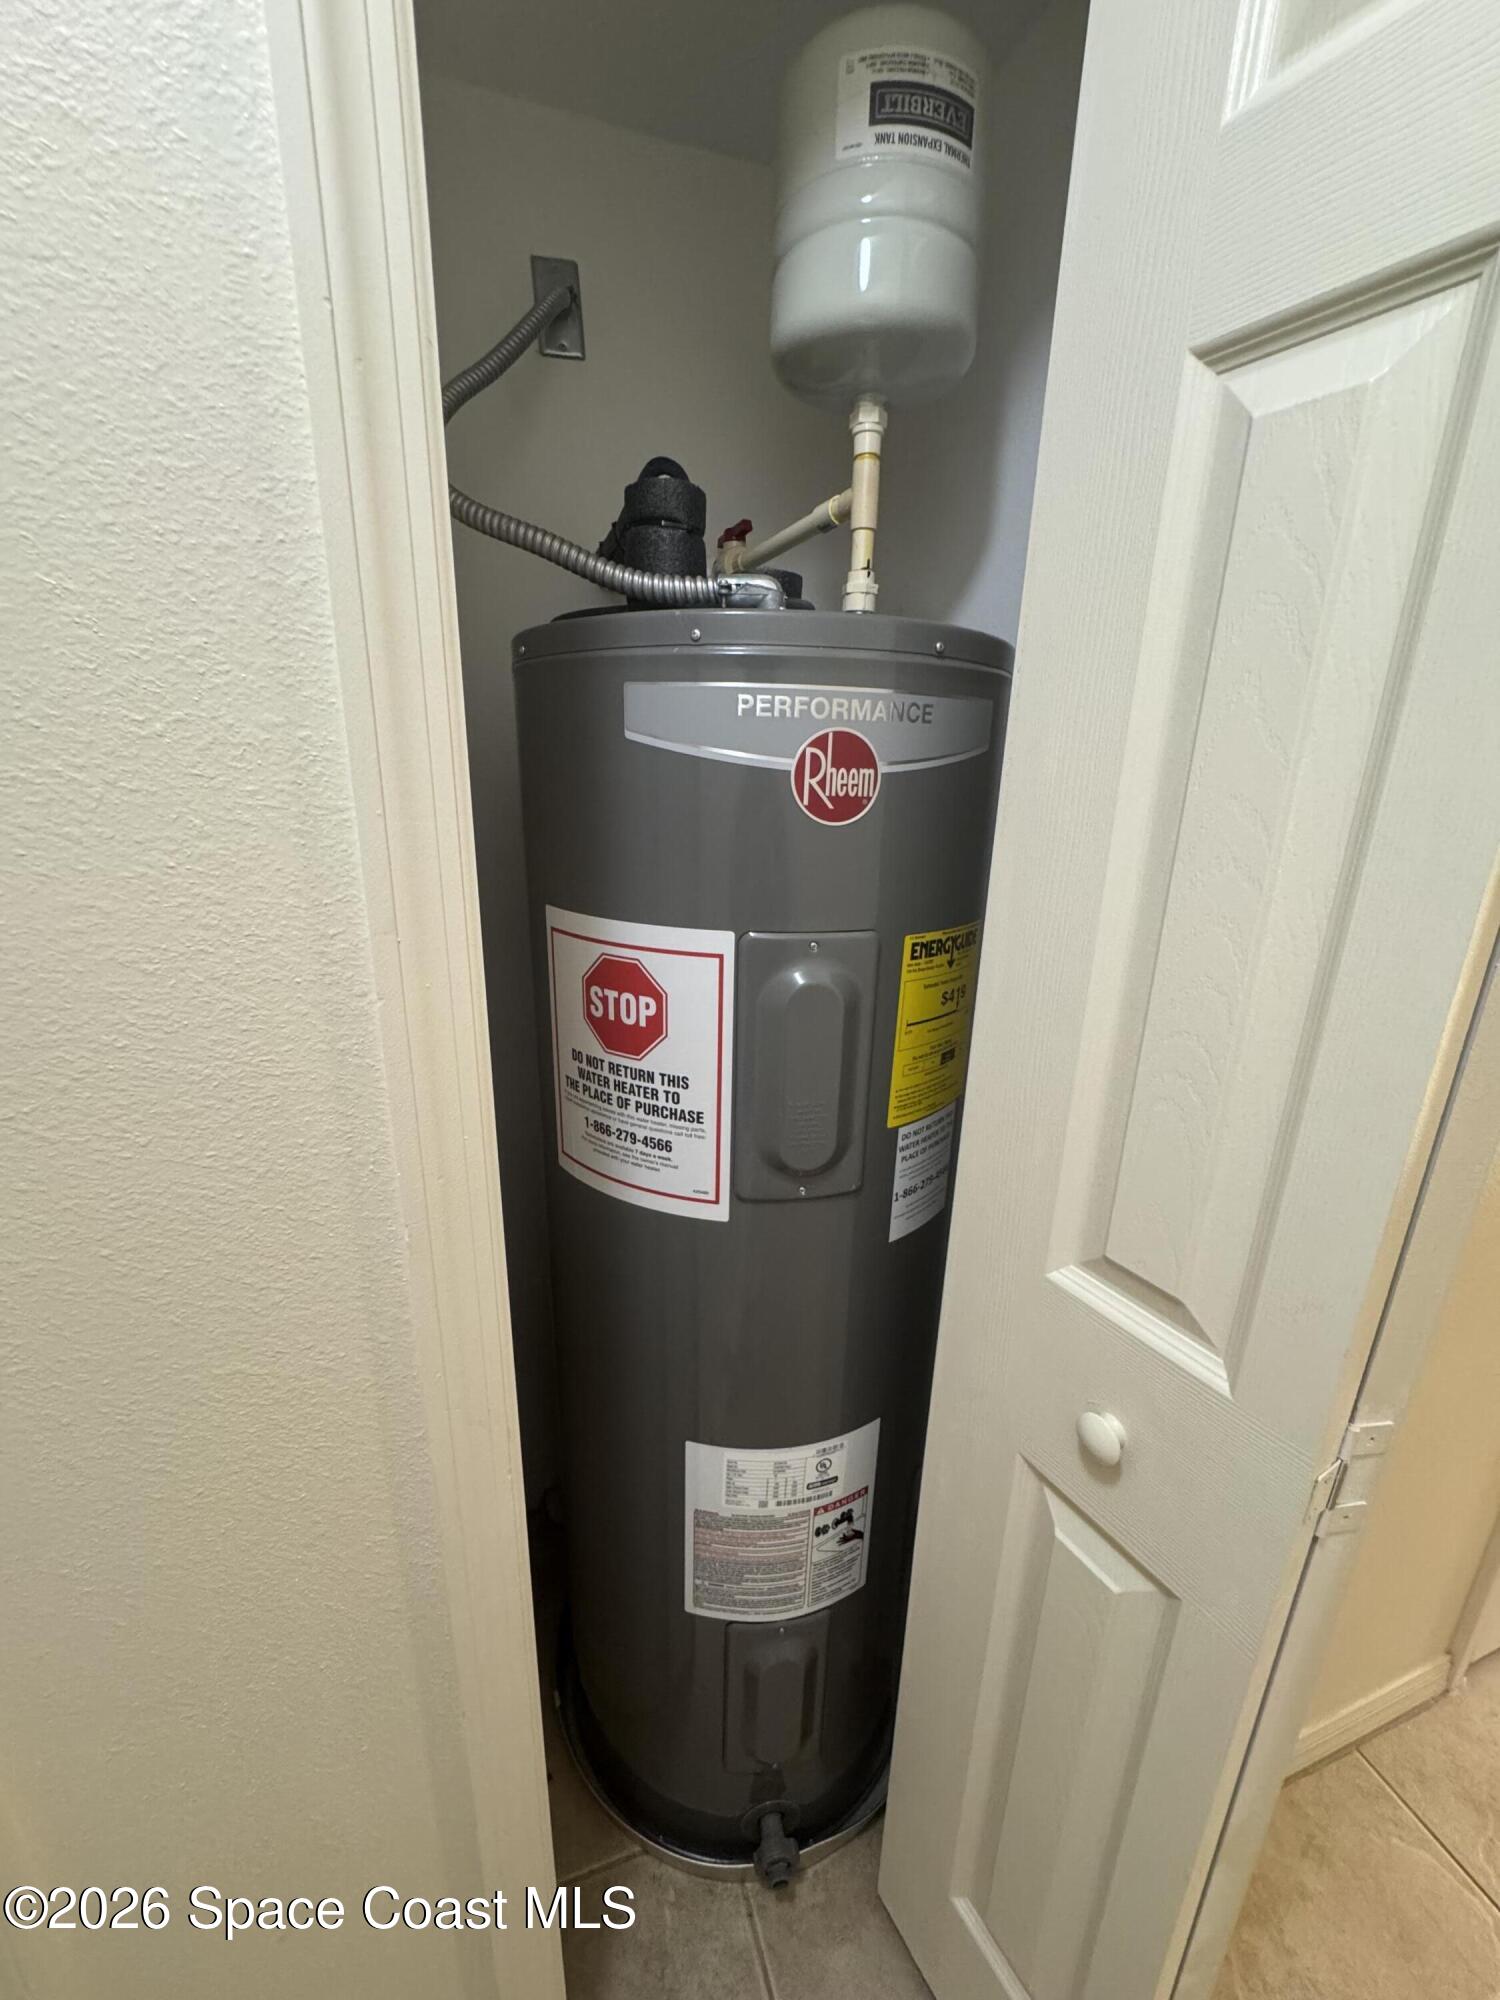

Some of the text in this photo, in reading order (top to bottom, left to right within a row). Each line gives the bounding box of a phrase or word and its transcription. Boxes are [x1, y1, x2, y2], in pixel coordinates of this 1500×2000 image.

[881, 93, 967, 133] EVERBILT
[874, 132, 971, 169] THERMAL EXPANSION TANK
[736, 693, 935, 725] PERFORMANCE
[802, 732, 875, 809] Rheem
[589, 985, 657, 1028] STOP
[571, 1047, 690, 1090] DO NOT RETURN THIS
[577, 1066, 610, 1090] WATER
[613, 1079, 659, 1101] HEATER
[663, 1089, 680, 1105] TO
[565, 1075, 580, 1093] THE
[582, 1083, 613, 1106] PLACE
[617, 1096, 631, 1111] OF
[635, 1101, 705, 1125] PURCHASE
[584, 1116, 674, 1153] 1-866-279-4566
[899, 1141, 920, 1153] WATER
[901, 1131, 911, 1142] DO
[913, 1125, 925, 1138] NOT
[901, 1151, 919, 1163] PLACE
[827, 1489, 866, 1511] DANGER
